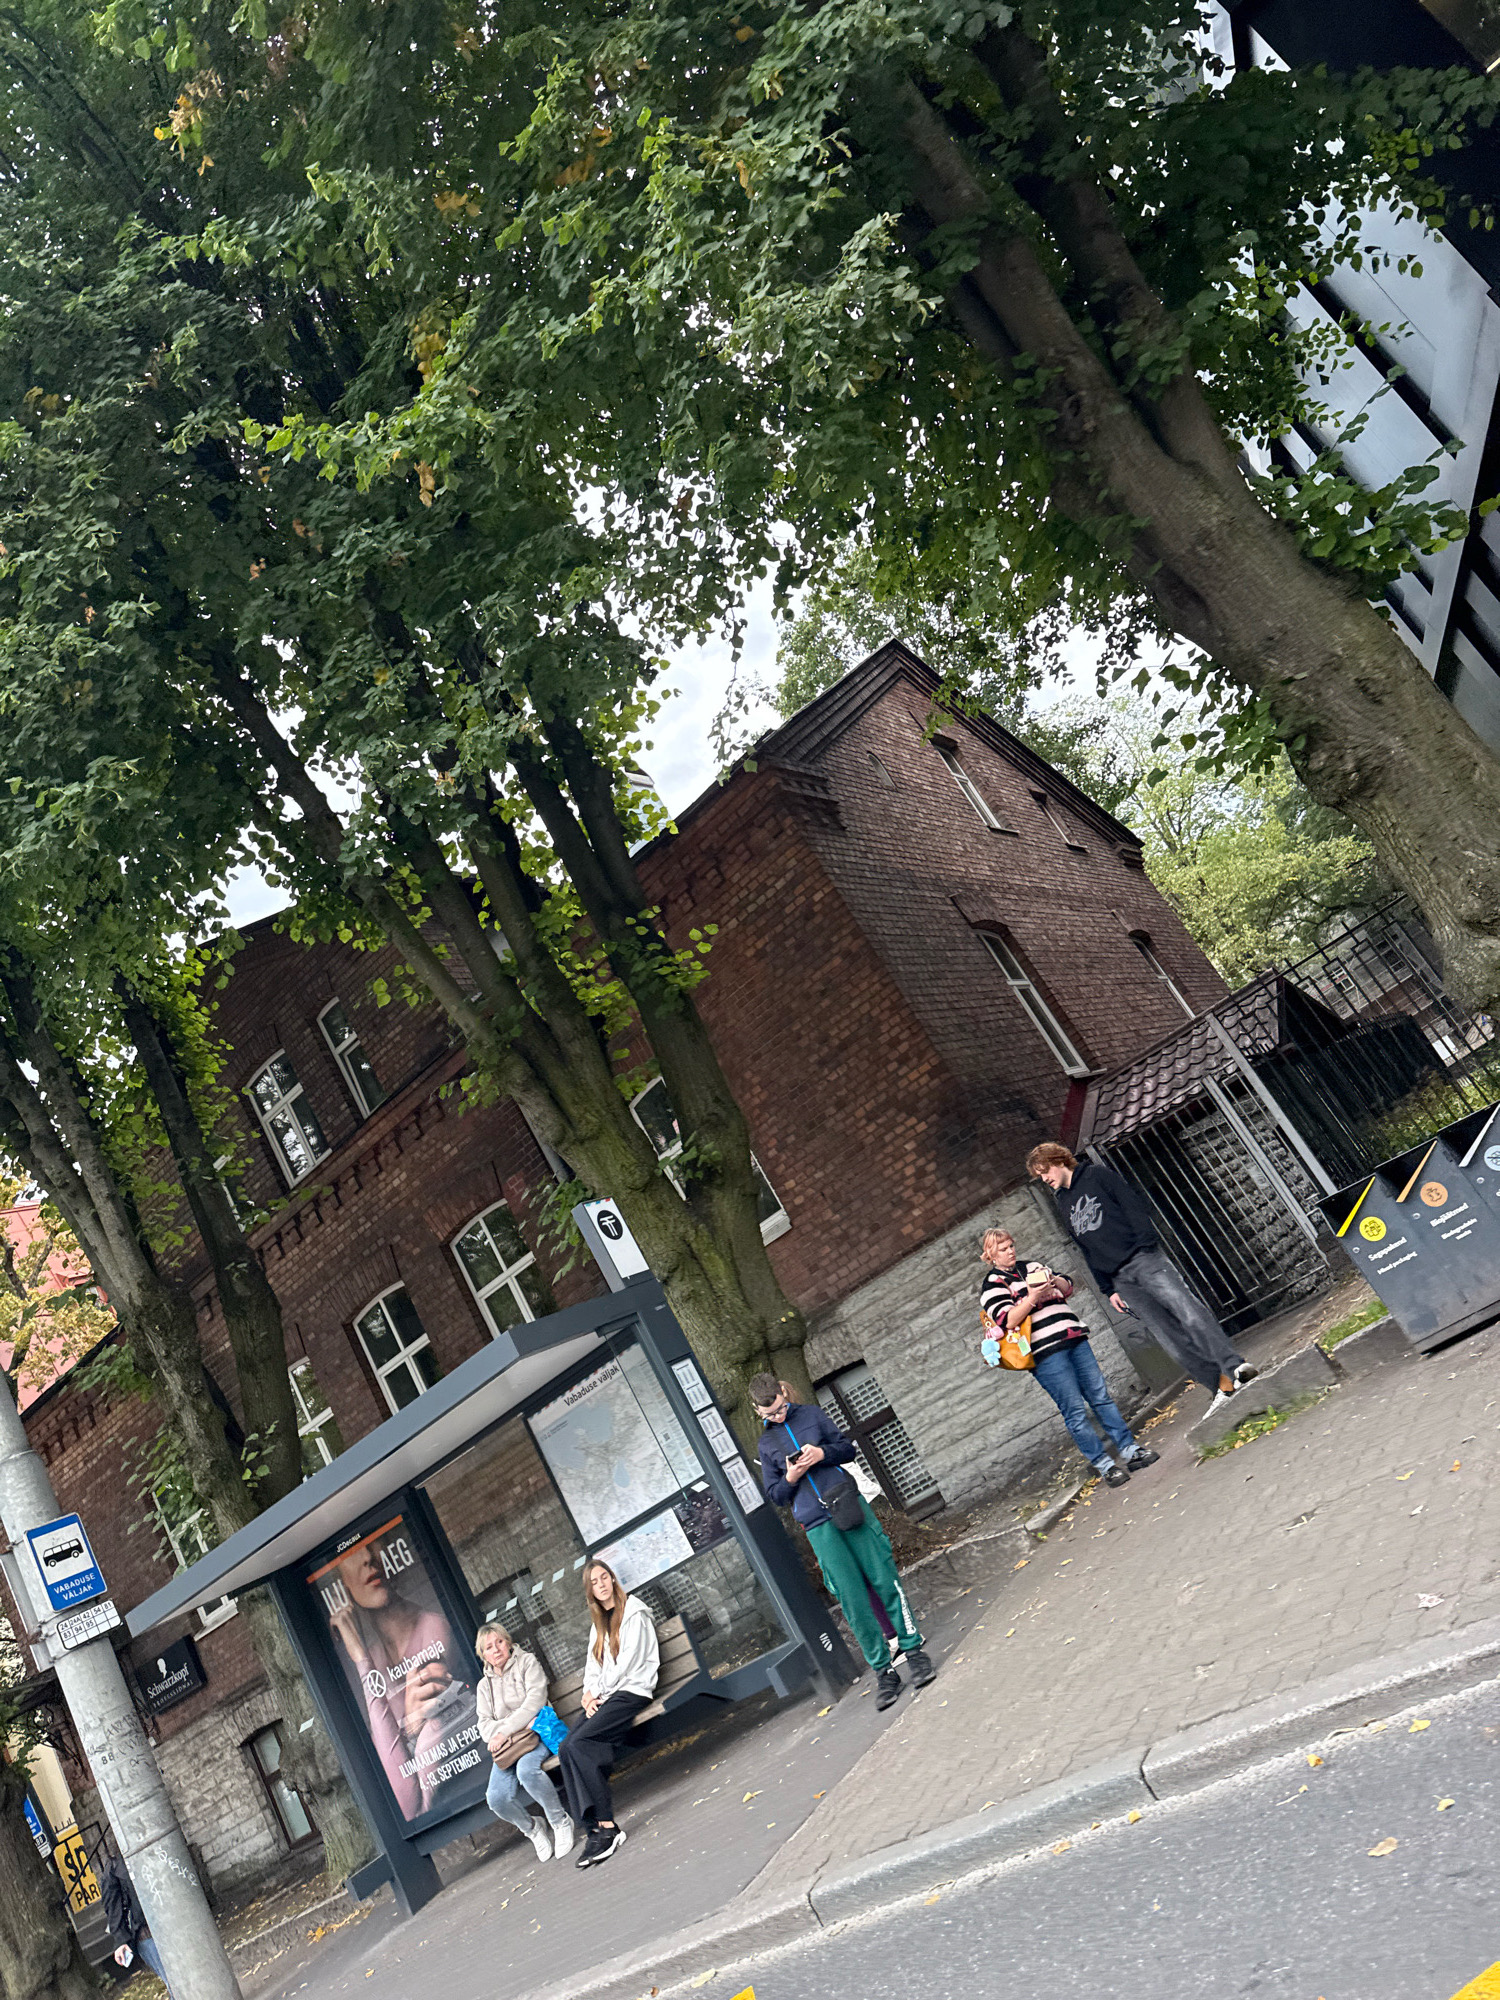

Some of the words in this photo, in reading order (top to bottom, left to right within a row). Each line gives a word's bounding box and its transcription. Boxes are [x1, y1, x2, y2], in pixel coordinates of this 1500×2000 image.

[1367, 1236, 1407, 1261] Segapakend
[563, 1380, 598, 1407] Vabaduse
[597, 1365, 620, 1389] väljak
[336, 1533, 361, 1553] JCDecaux
[53, 1572, 96, 1594] VABADUSE
[321, 1579, 349, 1616] ILU
[380, 1538, 414, 1579] AEG
[62, 1583, 94, 1601] VÄLJAK
[60, 1623, 68, 1631] 24
[70, 1617, 80, 1626] 24A
[82, 1612, 91, 1620] 42
[93, 1607, 101, 1615] 54
[104, 1602, 112, 1610] 81
[74, 1625, 82, 1634] 94
[85, 1620, 94, 1628] 95
[386, 1640, 445, 1682] kaubamaja
[147, 1662, 190, 1699] Schwarzkopf
[101, 1752, 115, 1765] 88
[398, 1743, 449, 1779] ILUMAAILMAS
[448, 1736, 460, 1754] JA
[458, 1724, 481, 1747] E-POE
[419, 1772, 440, 1791] 4.-13.
[437, 1749, 482, 1782] SEPTEMBER
[74, 1883, 101, 1907] PAR
